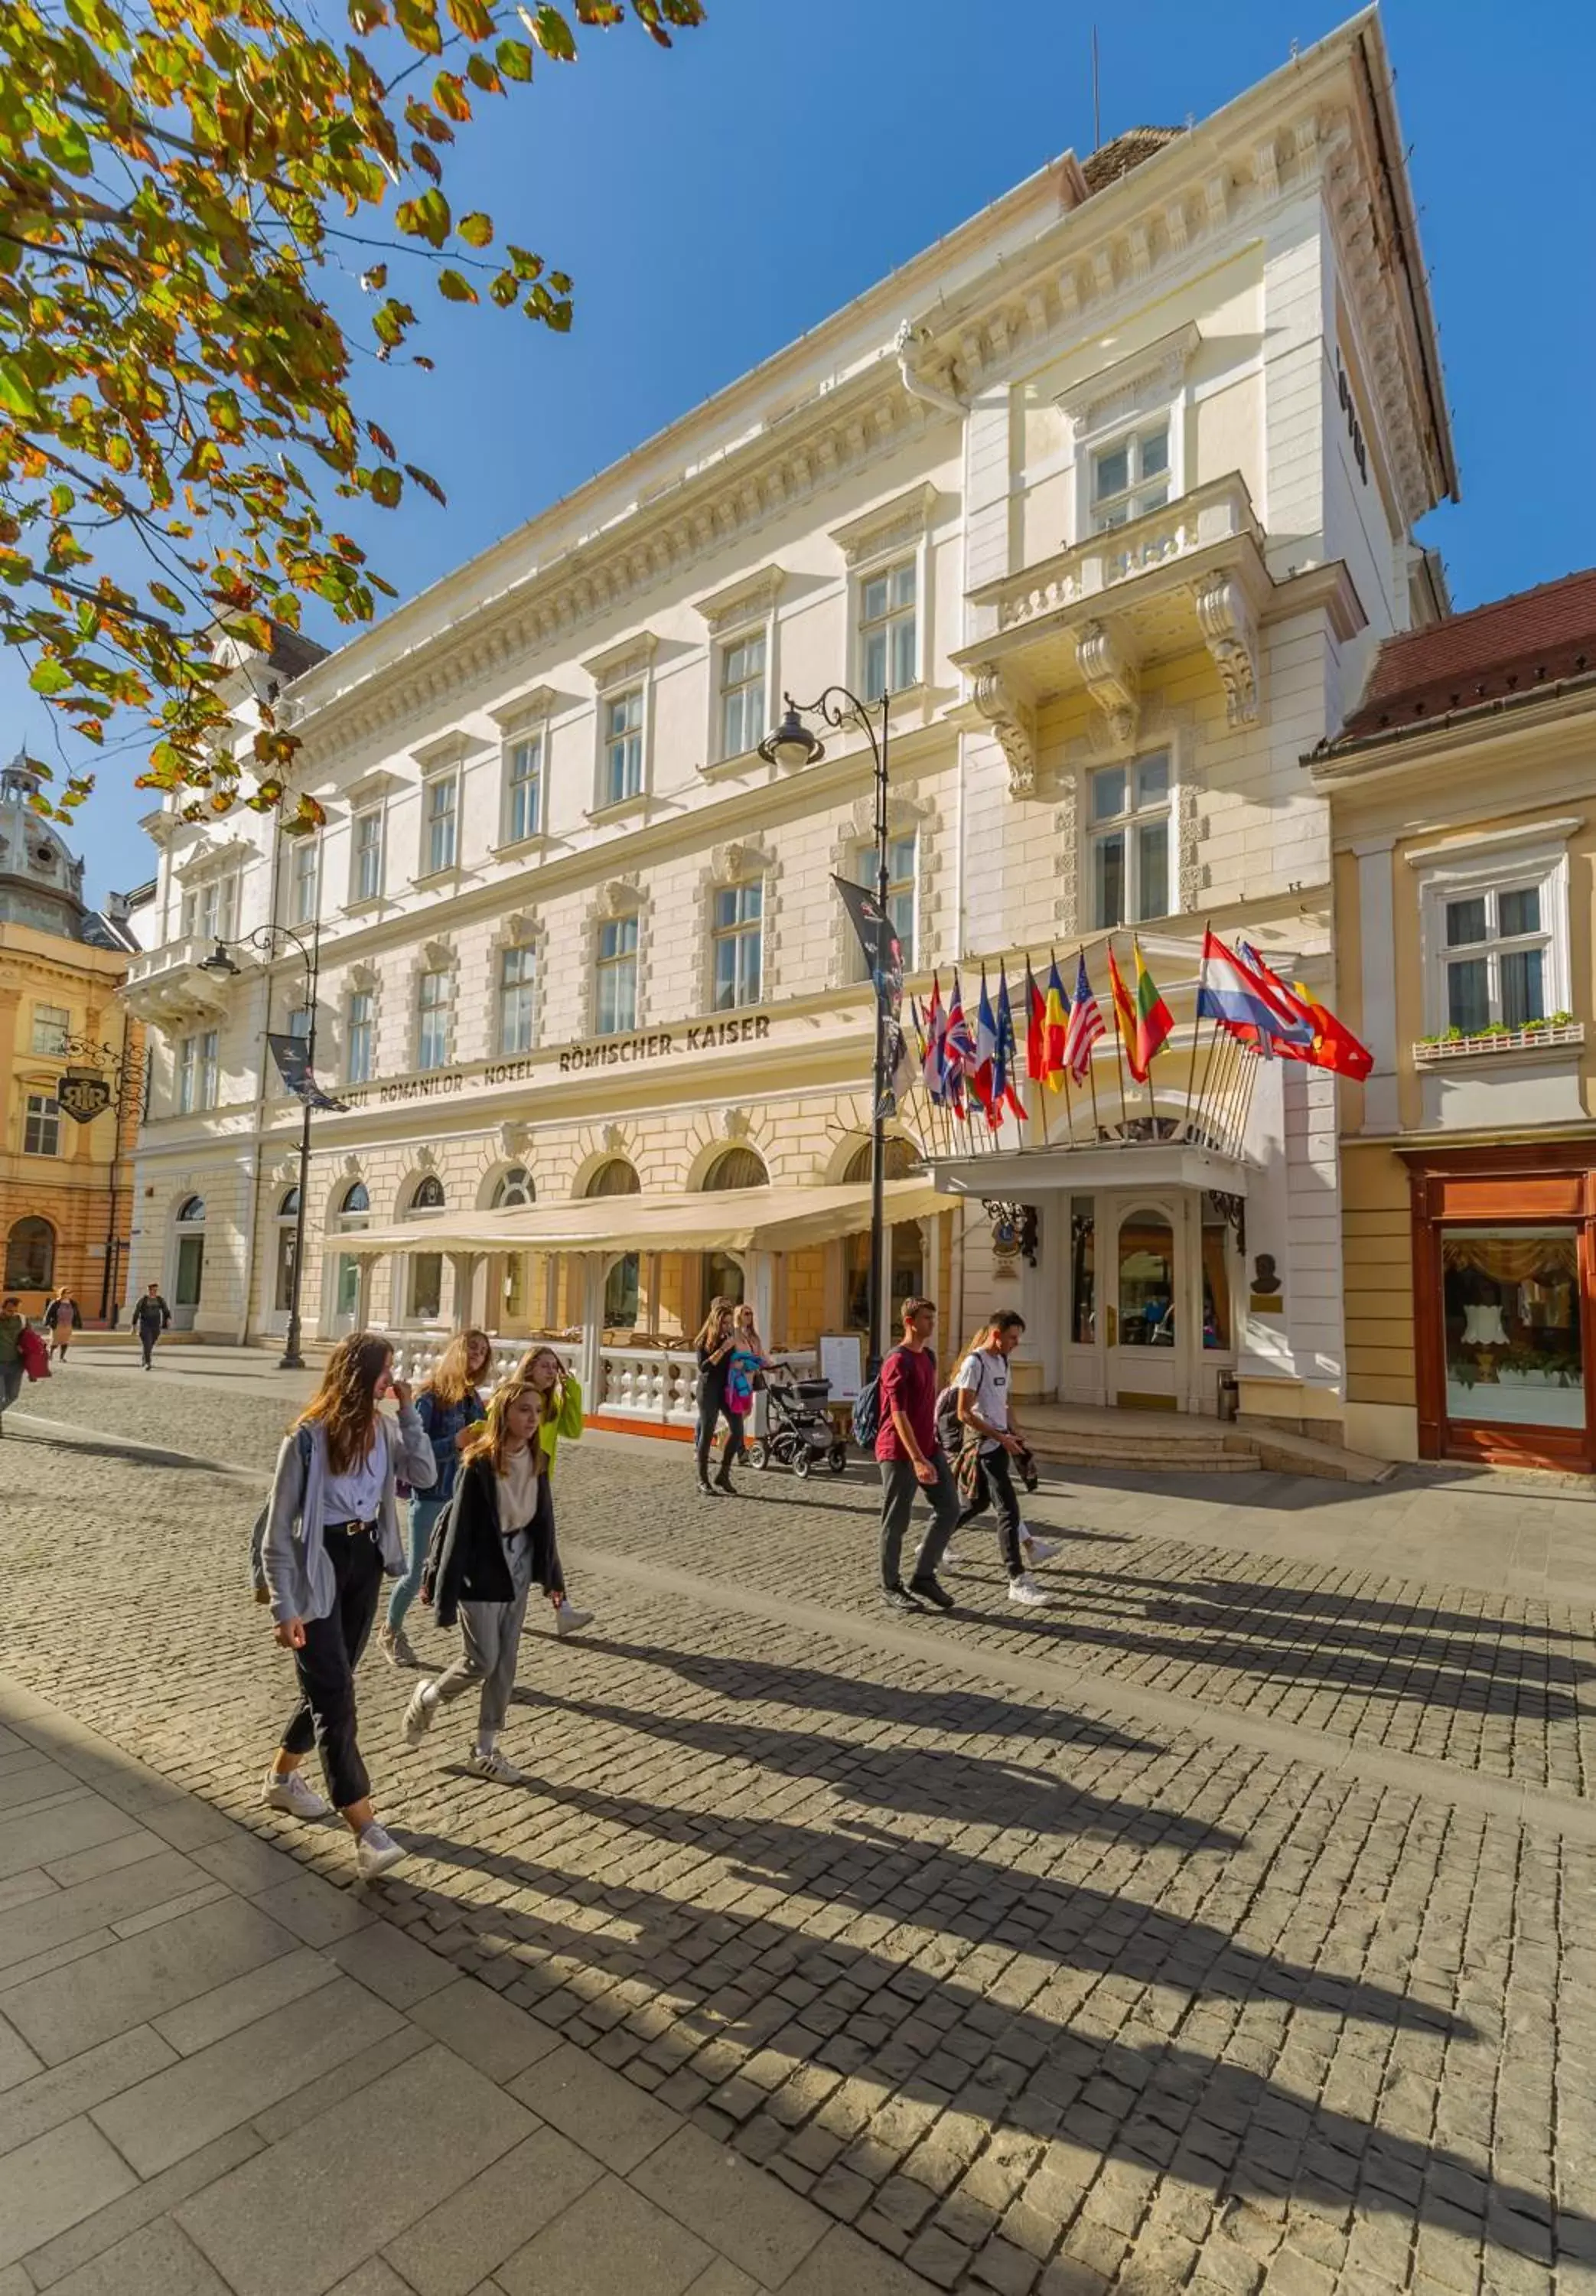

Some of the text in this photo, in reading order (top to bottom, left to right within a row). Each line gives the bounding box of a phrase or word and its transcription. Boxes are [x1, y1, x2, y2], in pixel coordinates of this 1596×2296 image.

[379, 1074, 463, 1104] ROMANILOR
[484, 1059, 535, 1086] HOTEL
[559, 1033, 673, 1071] RÖMISCHER
[686, 1016, 770, 1052] KAISER
